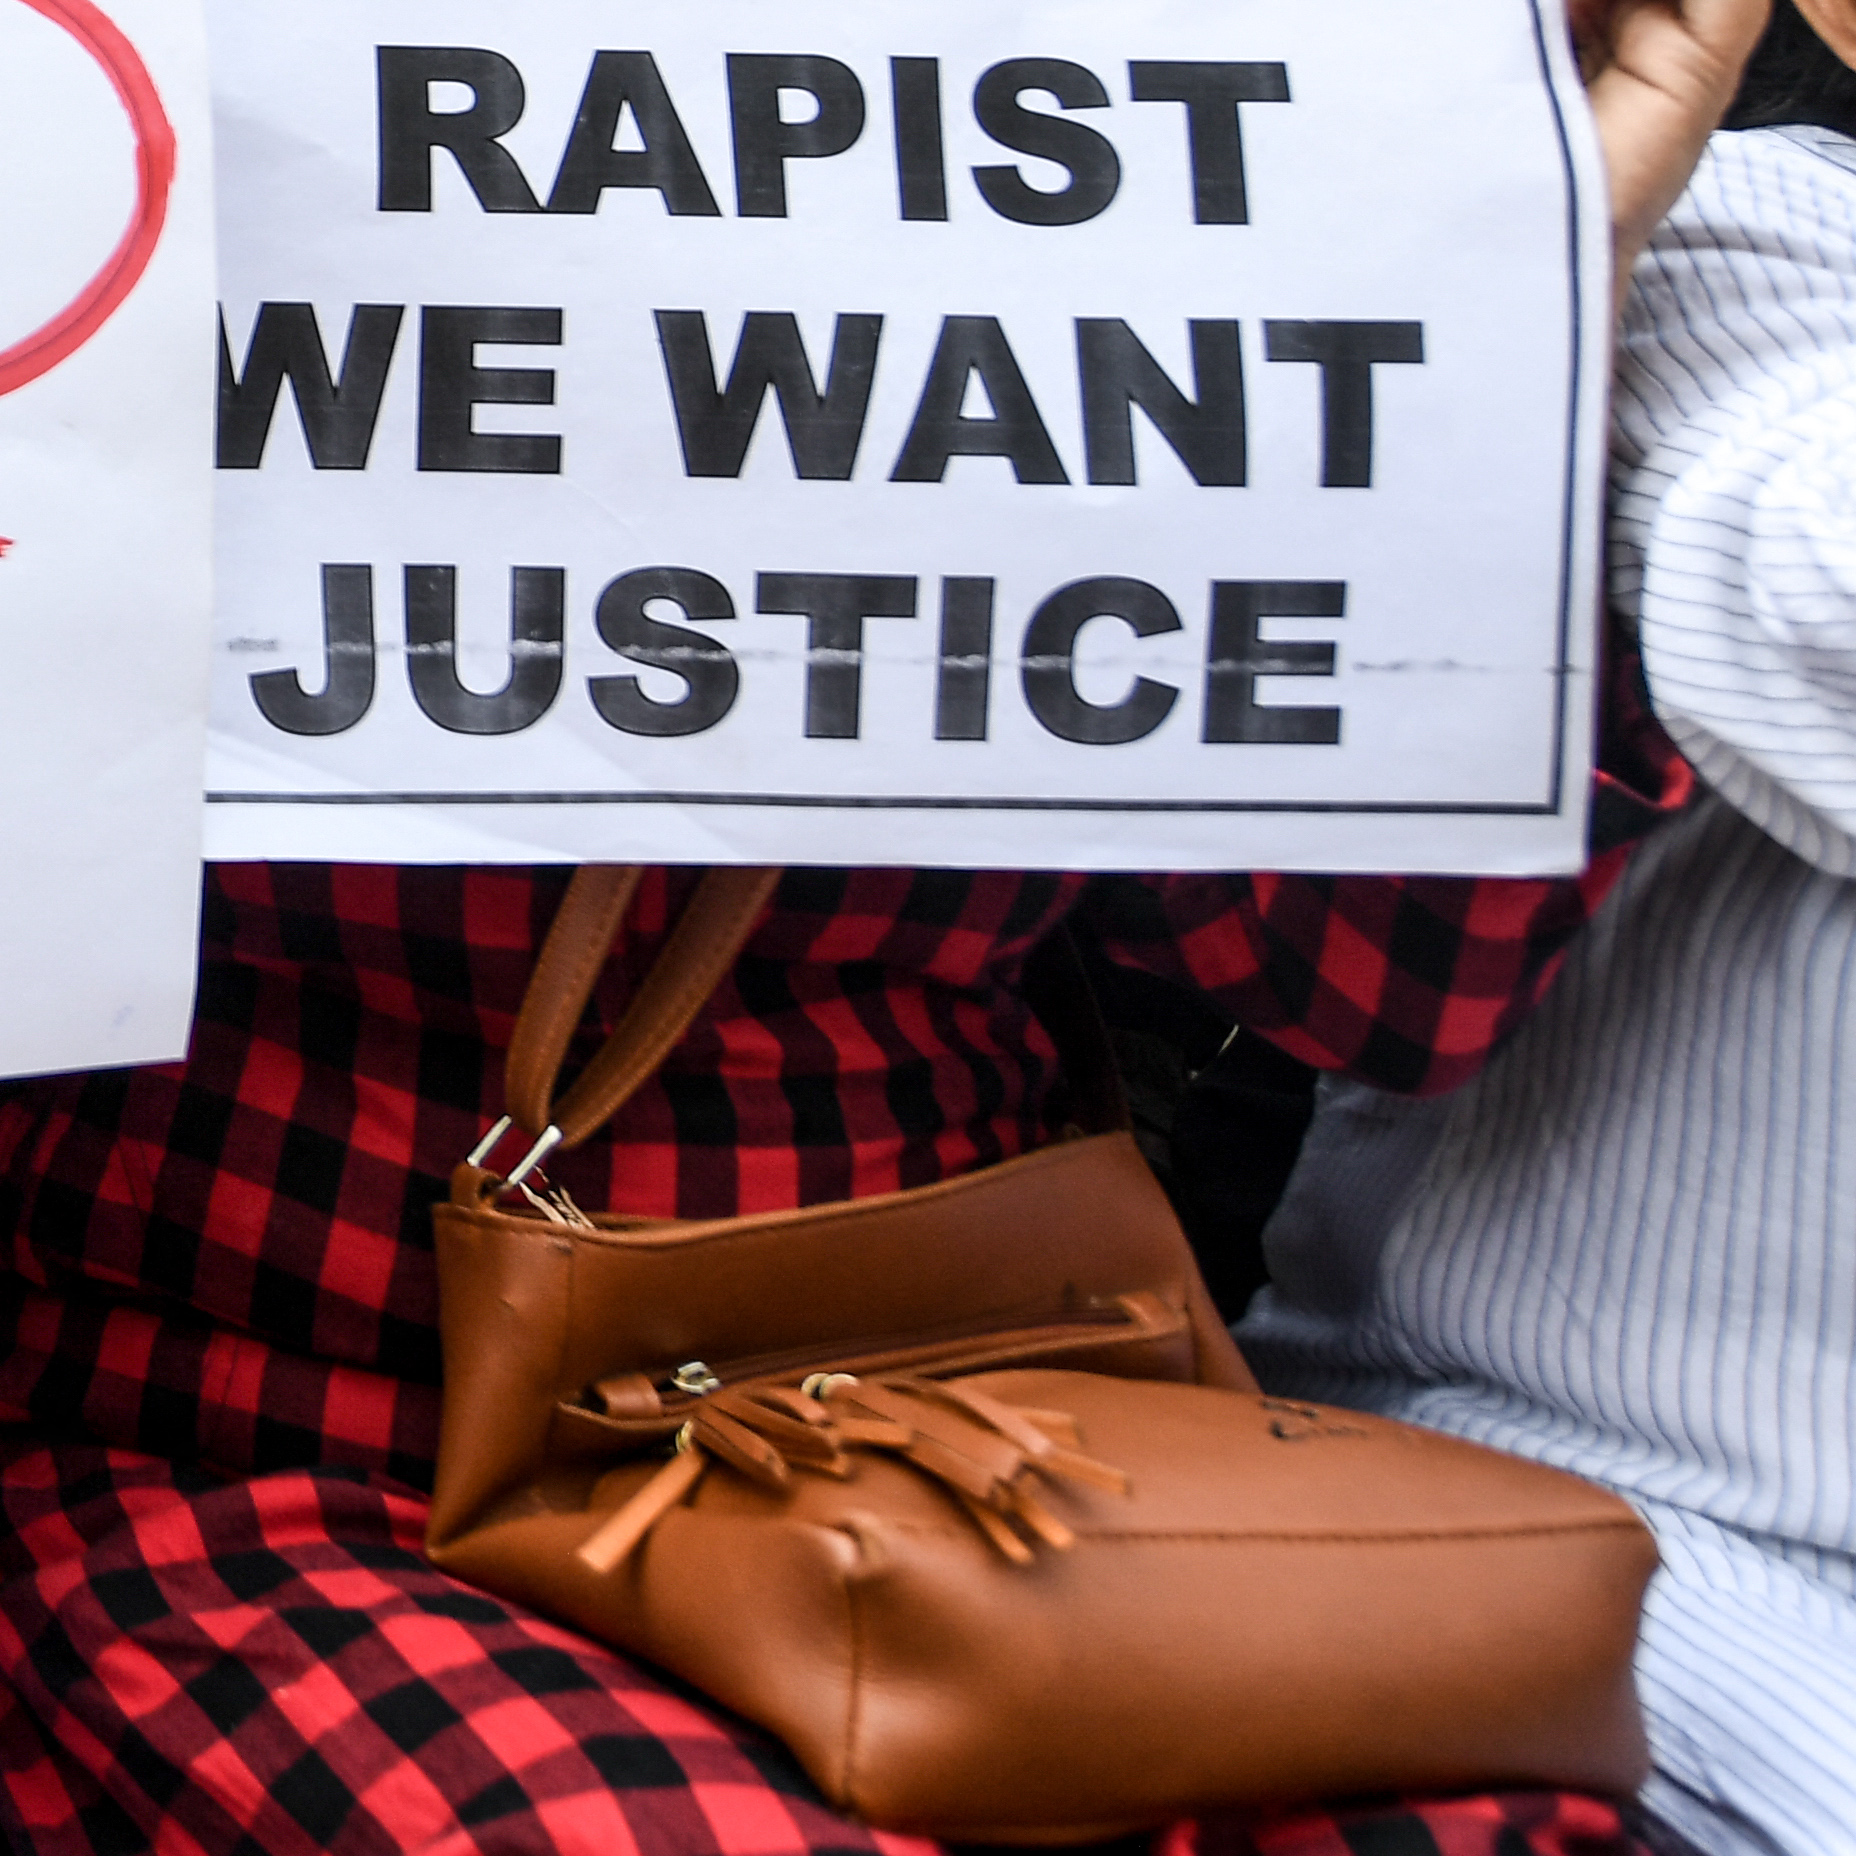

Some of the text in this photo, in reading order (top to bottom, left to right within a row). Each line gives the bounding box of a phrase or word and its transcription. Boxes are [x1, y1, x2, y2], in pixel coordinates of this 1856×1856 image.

[374, 44, 1292, 228] RAPIST
[215, 299, 1426, 489] WE WANT
[248, 562, 1348, 747] JUSTICE
